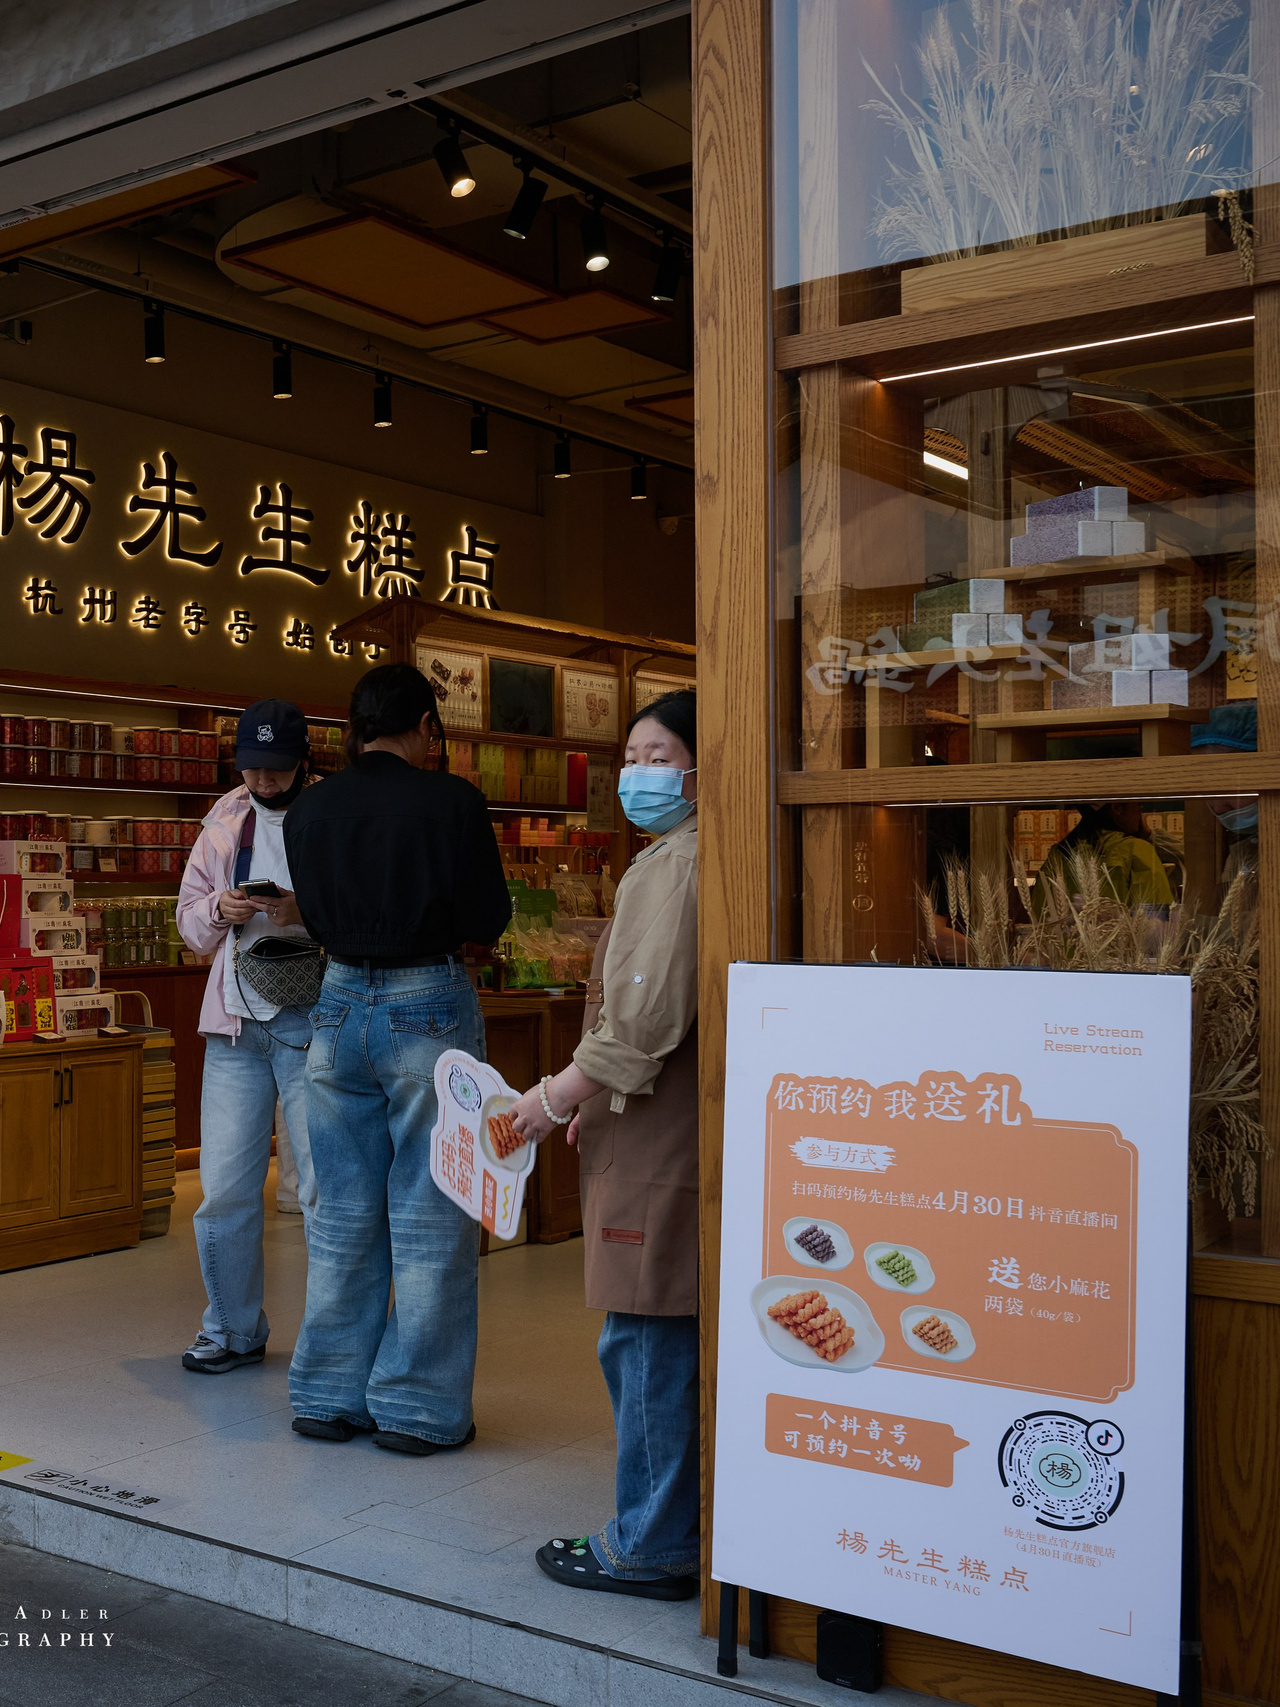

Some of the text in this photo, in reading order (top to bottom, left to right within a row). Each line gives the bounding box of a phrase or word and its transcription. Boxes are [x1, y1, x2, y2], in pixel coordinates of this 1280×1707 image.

[24, 577, 258, 645] 杭州老字号
[1043, 1022, 1144, 1040] Live Stream
[1043, 1039, 1143, 1057] Reservation
[805, 1143, 878, 1166] 参与方式
[794, 1409, 908, 1446] 一个抖音号
[69, 1479, 161, 1506] 小心地滑
[835, 1527, 1030, 1592] 楊先生糕点
[883, 1565, 982, 1597] MASTER YANG
